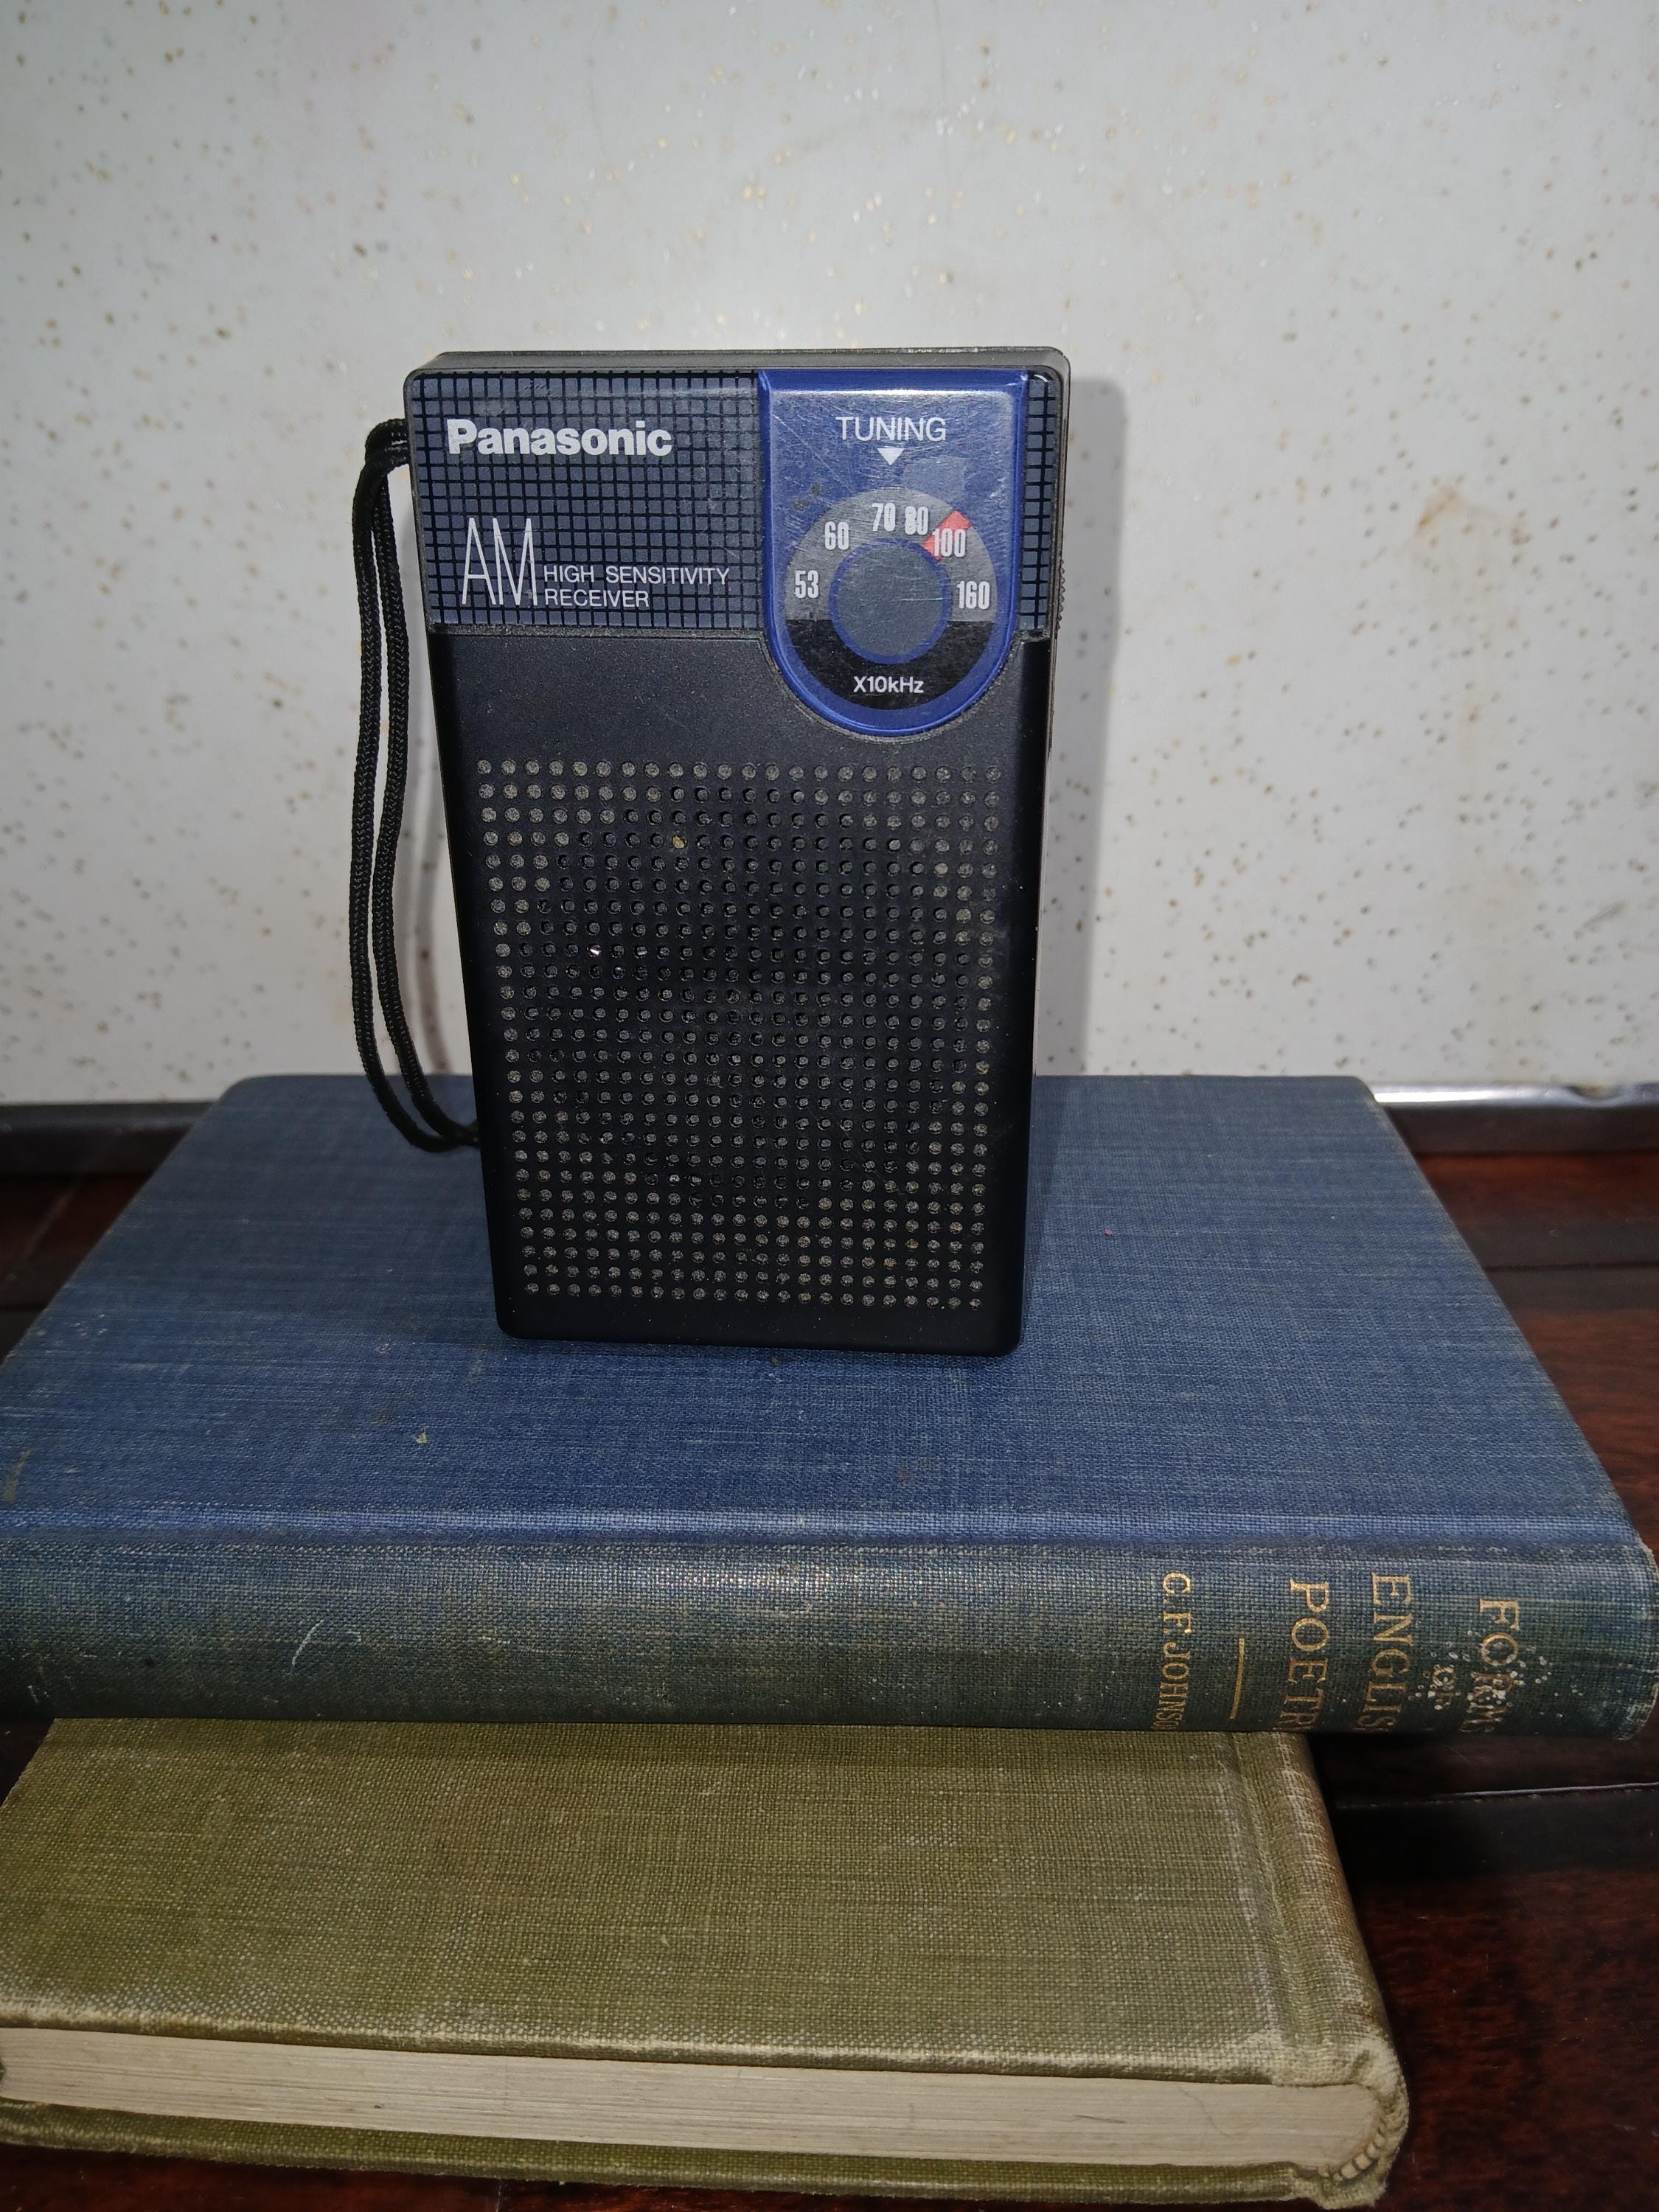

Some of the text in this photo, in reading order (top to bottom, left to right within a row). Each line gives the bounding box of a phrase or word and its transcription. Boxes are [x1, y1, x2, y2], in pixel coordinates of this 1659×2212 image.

[447, 419, 672, 456] Panasonic
[835, 417, 947, 442] TUNING
[462, 518, 538, 605] AM
[795, 502, 991, 610] 53 60 70 80 100 160
[543, 565, 730, 585] HIGH SENSITIVITY
[544, 590, 650, 608] RECEIVER
[853, 675, 925, 694] X10kHz
